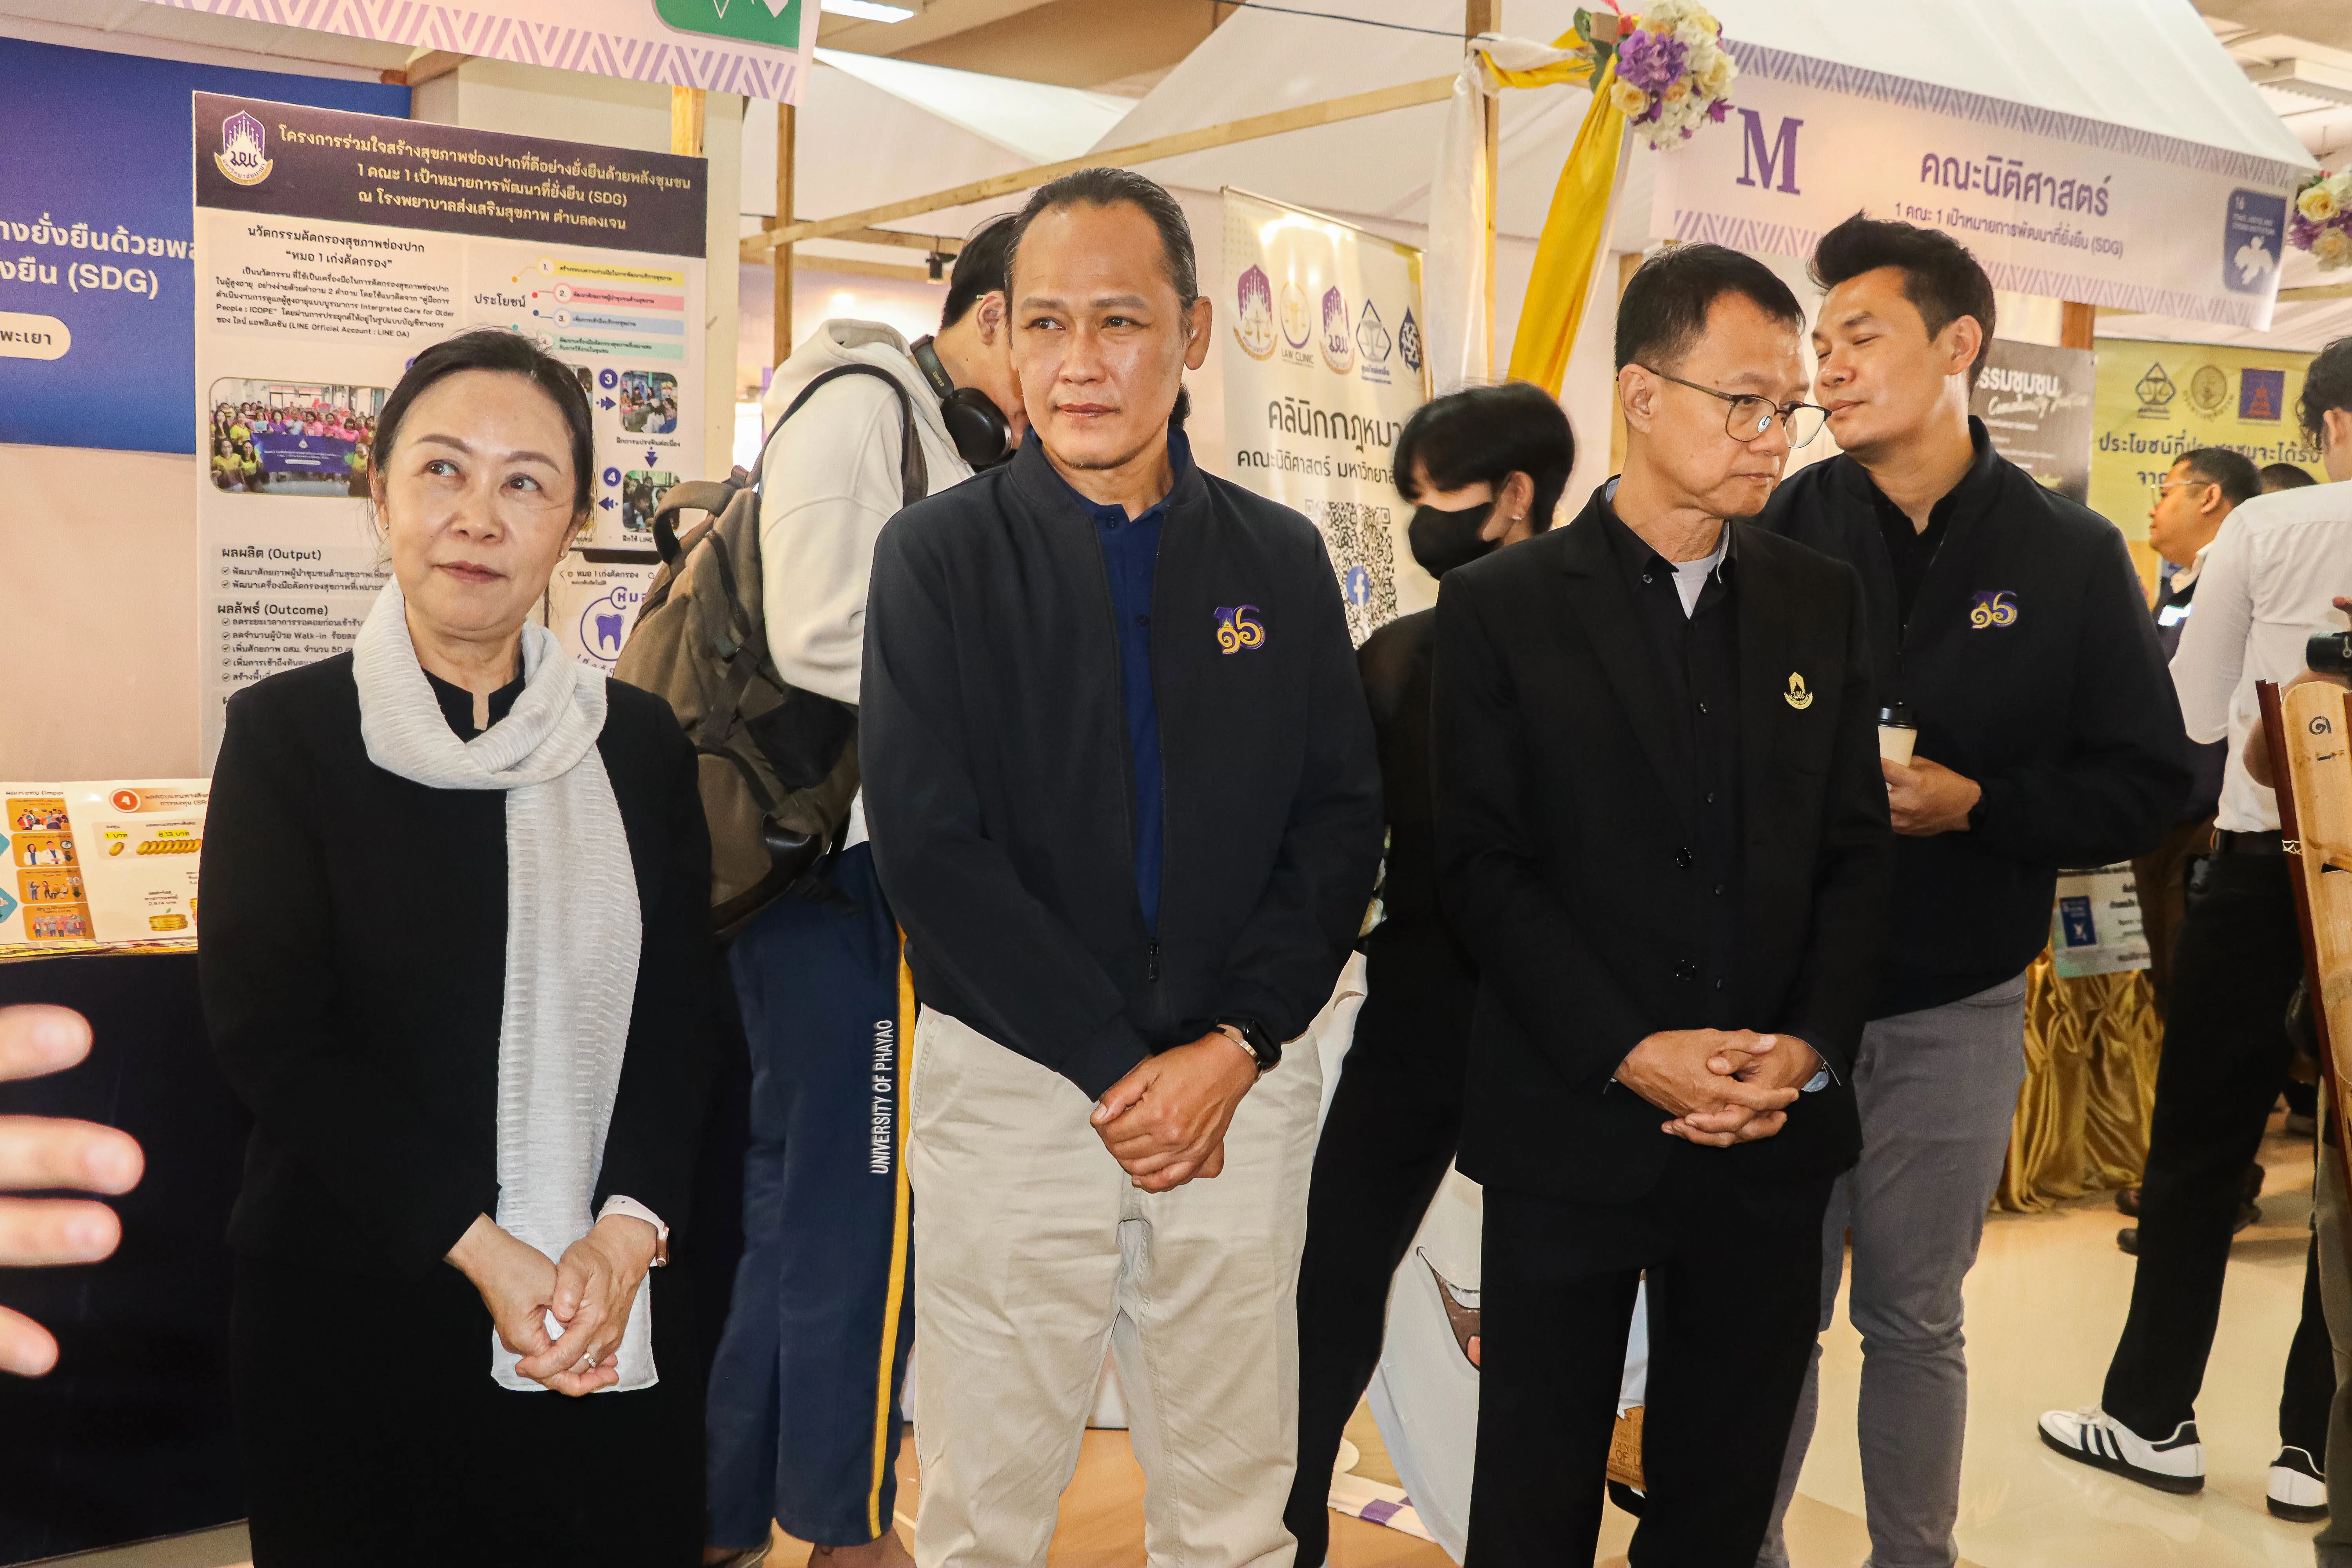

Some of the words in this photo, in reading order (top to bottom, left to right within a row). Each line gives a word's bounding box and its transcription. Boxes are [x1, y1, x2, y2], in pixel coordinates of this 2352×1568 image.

[1737, 107, 1803, 195] M
[358, 163, 363, 176] 1
[367, 166, 399, 180] คณะ
[405, 169, 411, 181] 1
[414, 168, 585, 201] เป้าหมายการพัฒนาที่ยั่งยืน
[588, 189, 628, 208] (SDG)
[1921, 152, 2112, 216] คณะนิติศาสตร์
[358, 191, 373, 203] ณ
[376, 188, 550, 224] โรงพยาบาลส่งเสริมสุขภาพ
[248, 225, 425, 253] นวัตกรรมคัดกรองสุขภาพช่องปาก
[1895, 202, 1901, 216] 1
[1906, 205, 1933, 221] คณะ
[1936, 210, 1942, 223] 1
[1946, 208, 2088, 249] เป้าหมายการพัฒนาที่ยั่งยืน
[2091, 236, 2124, 258] (SDG)
[318, 253, 323, 262] 1
[68, 262, 159, 301] (SDG)
[216, 304, 243, 312] People
[474, 293, 526, 307] ประโยชน์
[289, 322, 309, 330] (LINE
[604, 373, 613, 385] 3
[608, 472, 617, 482] 4
[1238, 449, 1331, 477] คณะนิติศาสตร์
[222, 546, 264, 558] ผลผลิต
[268, 548, 322, 561] (Output)
[218, 601, 260, 614] ผลลัพธ์
[264, 604, 328, 616] (Outcome)
[872, 1020, 893, 1071] PHAYAO
[871, 1074, 892, 1093] OF
[870, 1095, 892, 1174] UNIVERSITY
